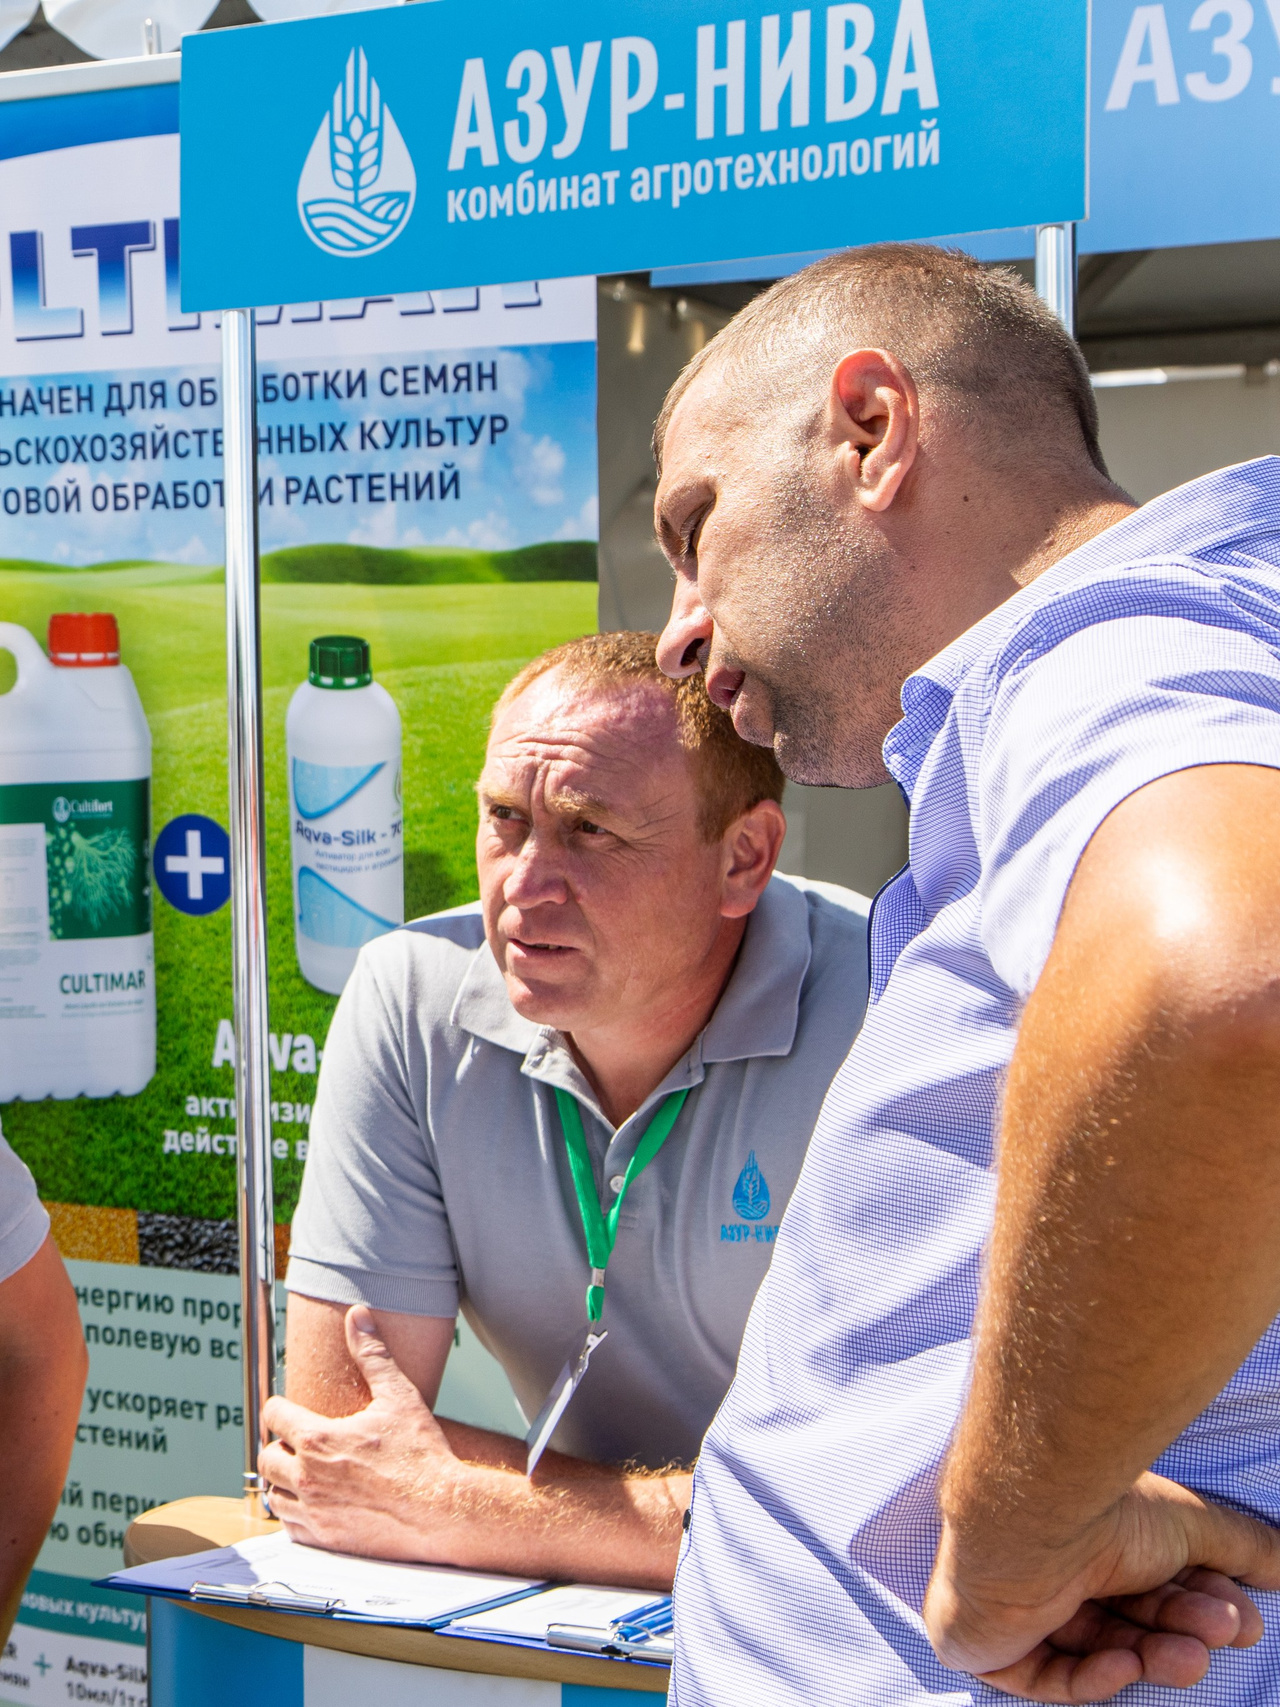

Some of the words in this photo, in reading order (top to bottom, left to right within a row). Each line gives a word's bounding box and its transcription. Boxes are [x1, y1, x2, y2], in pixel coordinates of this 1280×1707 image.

[447, 0, 940, 171] АЗУР-НИВА
[447, 169, 620, 223] комбинат
[630, 117, 941, 209] агротехнологий
[104, 379, 168, 418] ДЛЯ
[177, 367, 369, 408] ОББОТКИ
[379, 359, 499, 398] СЕМЯН
[359, 412, 510, 451] КУЛЬТУР
[91, 477, 275, 512] ОБРАБОТИ
[284, 462, 462, 506] РАСТЕНИЙ
[295, 820, 377, 847] Aqva-Silk
[60, 970, 146, 995] CULTIMAR
[163, 1126, 289, 1159] дейсте
[75, 1285, 175, 1315] нергию
[85, 1323, 201, 1359] полевую
[86, 1387, 208, 1421] ускоряет
[75, 1423, 168, 1454] стений
